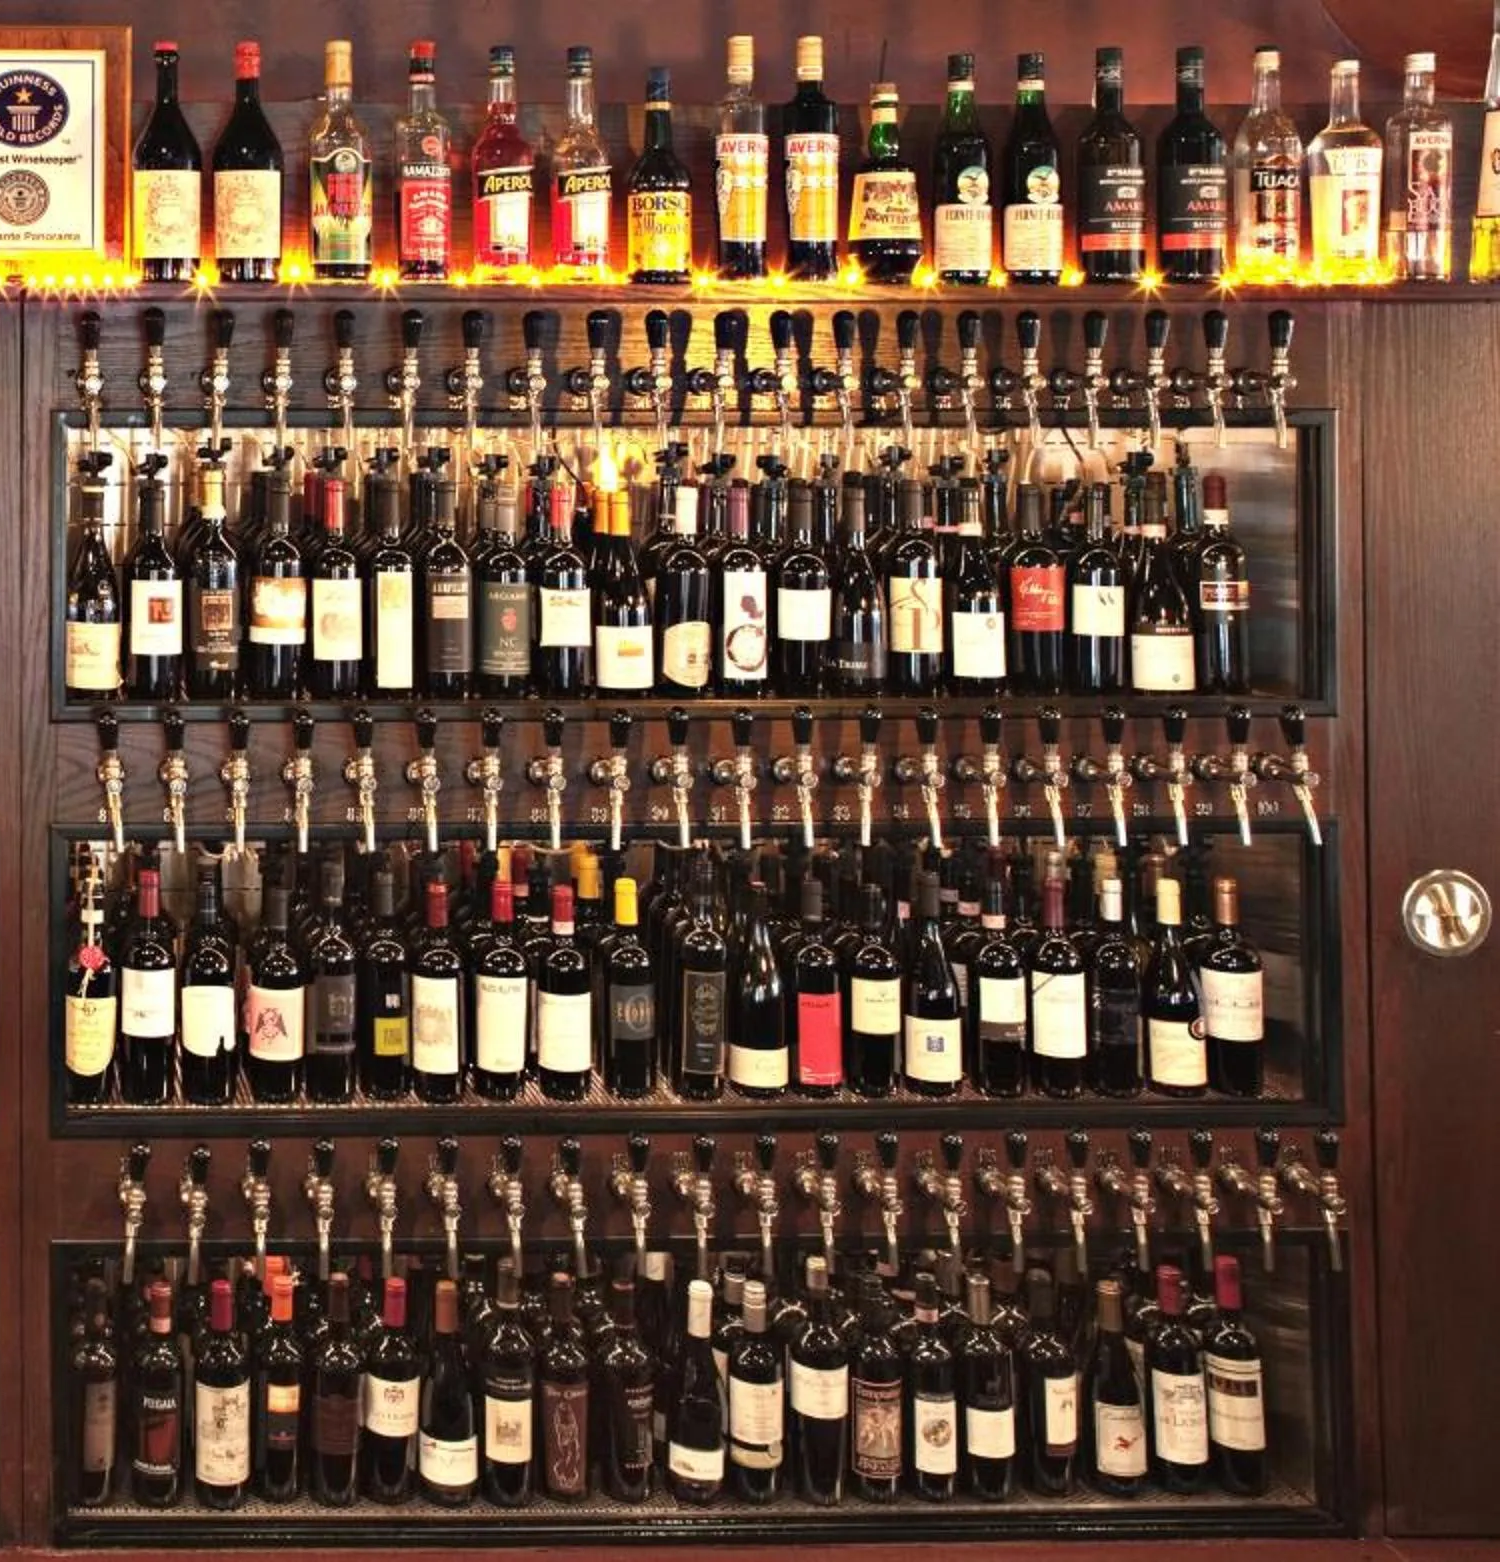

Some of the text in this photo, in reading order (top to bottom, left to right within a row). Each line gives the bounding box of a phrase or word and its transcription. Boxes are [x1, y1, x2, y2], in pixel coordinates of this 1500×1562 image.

[19, 103, 64, 143] RECORDS
[11, 154, 82, 167] Winekeeper"
[23, 231, 81, 241] Panorama
